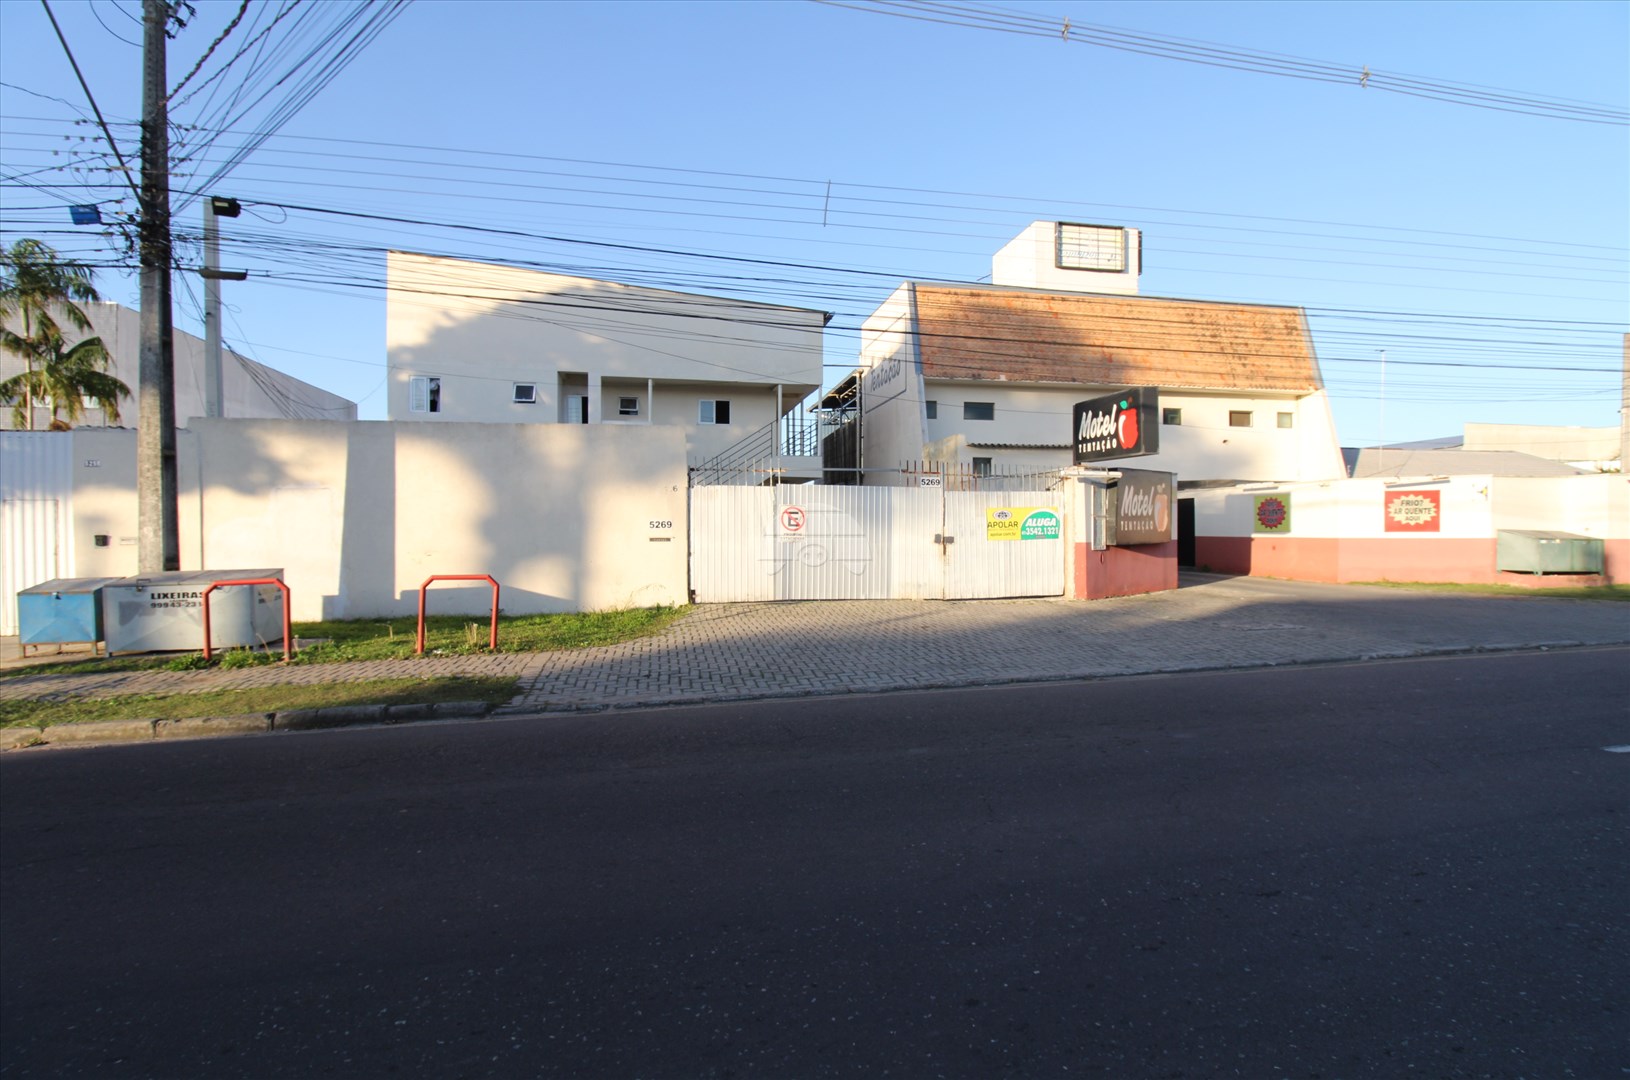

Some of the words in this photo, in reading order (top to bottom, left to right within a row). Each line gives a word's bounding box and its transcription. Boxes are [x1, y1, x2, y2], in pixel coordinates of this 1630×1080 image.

[1079, 404, 1117, 440] Motel
[1078, 438, 1117, 453] TENTAÇÃO
[921, 478, 941, 486] 5269
[1121, 485, 1154, 517] Motel
[649, 520, 672, 529] 5269
[1026, 518, 1056, 526] ALUGA
[1121, 520, 1153, 533] TENTAÇÃO
